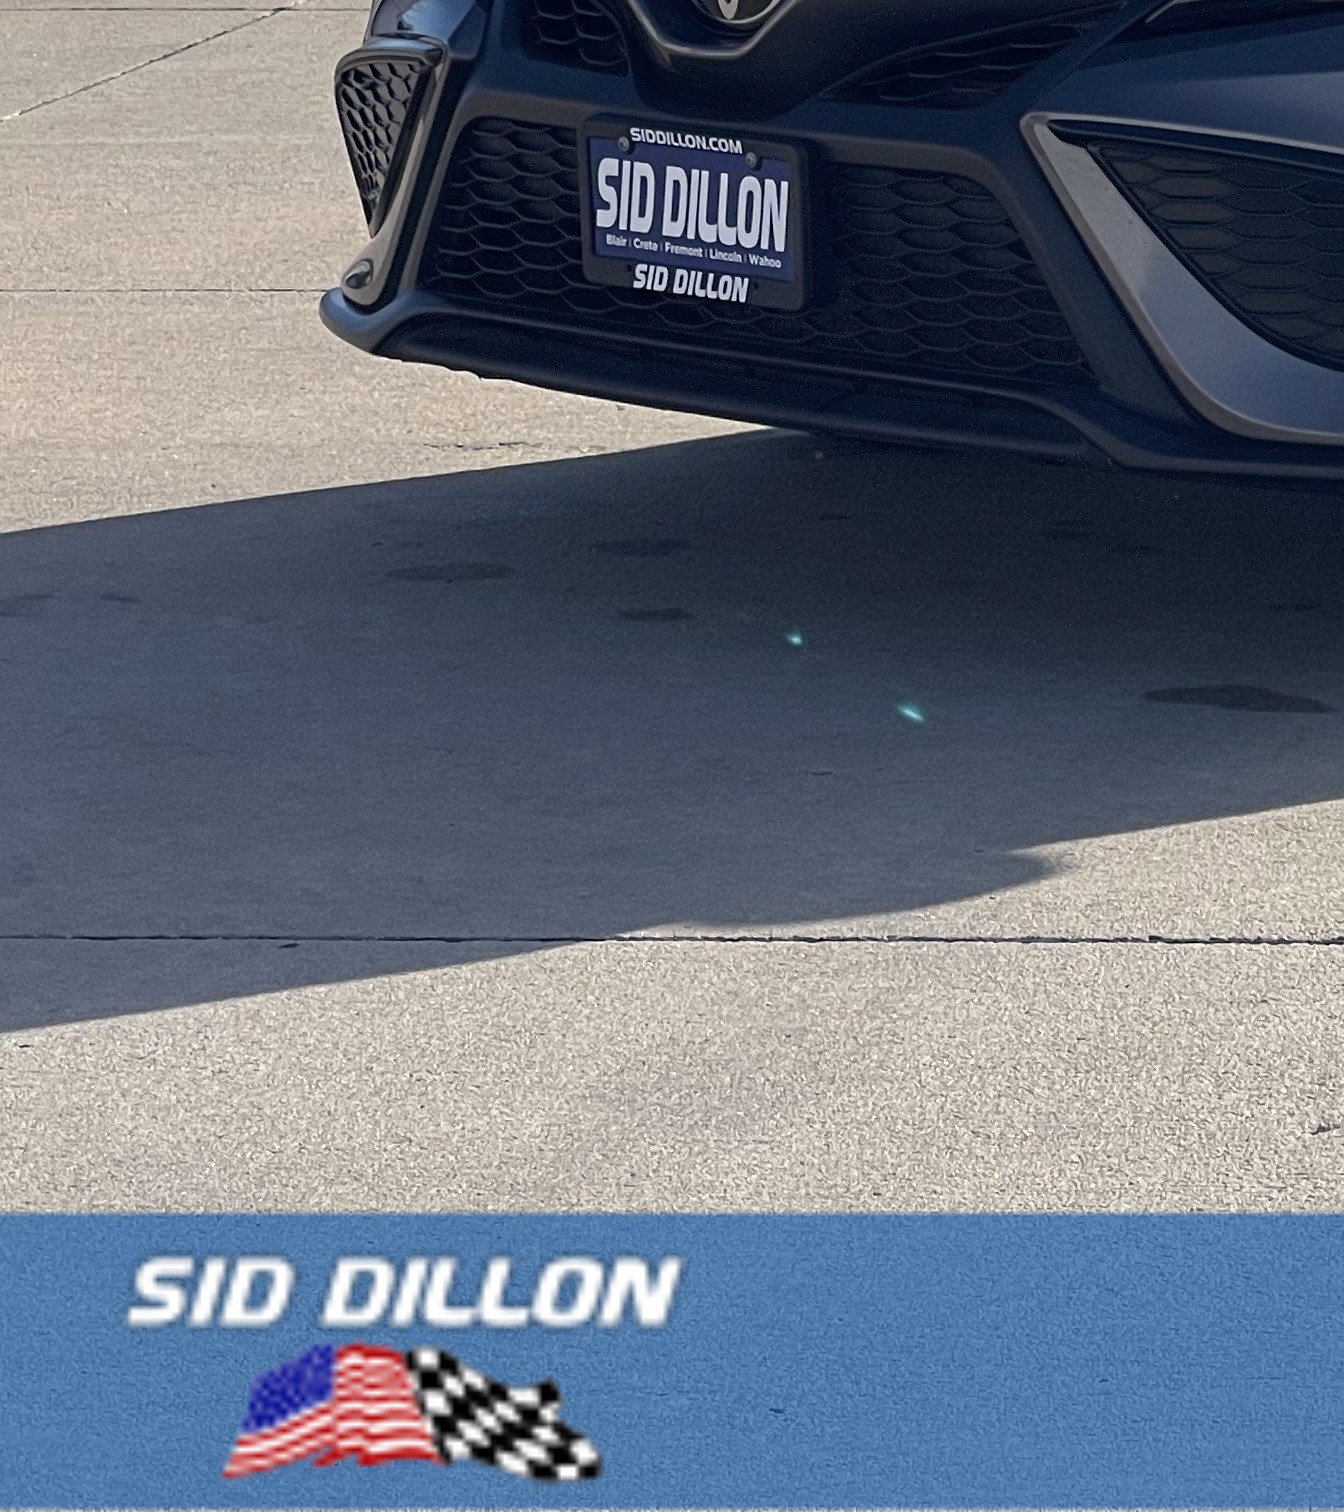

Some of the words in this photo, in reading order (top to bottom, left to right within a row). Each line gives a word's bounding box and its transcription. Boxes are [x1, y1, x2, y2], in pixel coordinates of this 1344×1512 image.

[630, 127, 742, 154] SIDDILLON.COM
[597, 157, 655, 233] SID
[662, 165, 788, 252] DILLON
[606, 233, 627, 247] Blair
[664, 242, 703, 258] Fremont
[709, 248, 742, 263] Lincoln
[749, 253, 781, 268] Wahoo
[633, 263, 668, 292] SID
[673, 268, 749, 303] DILLON
